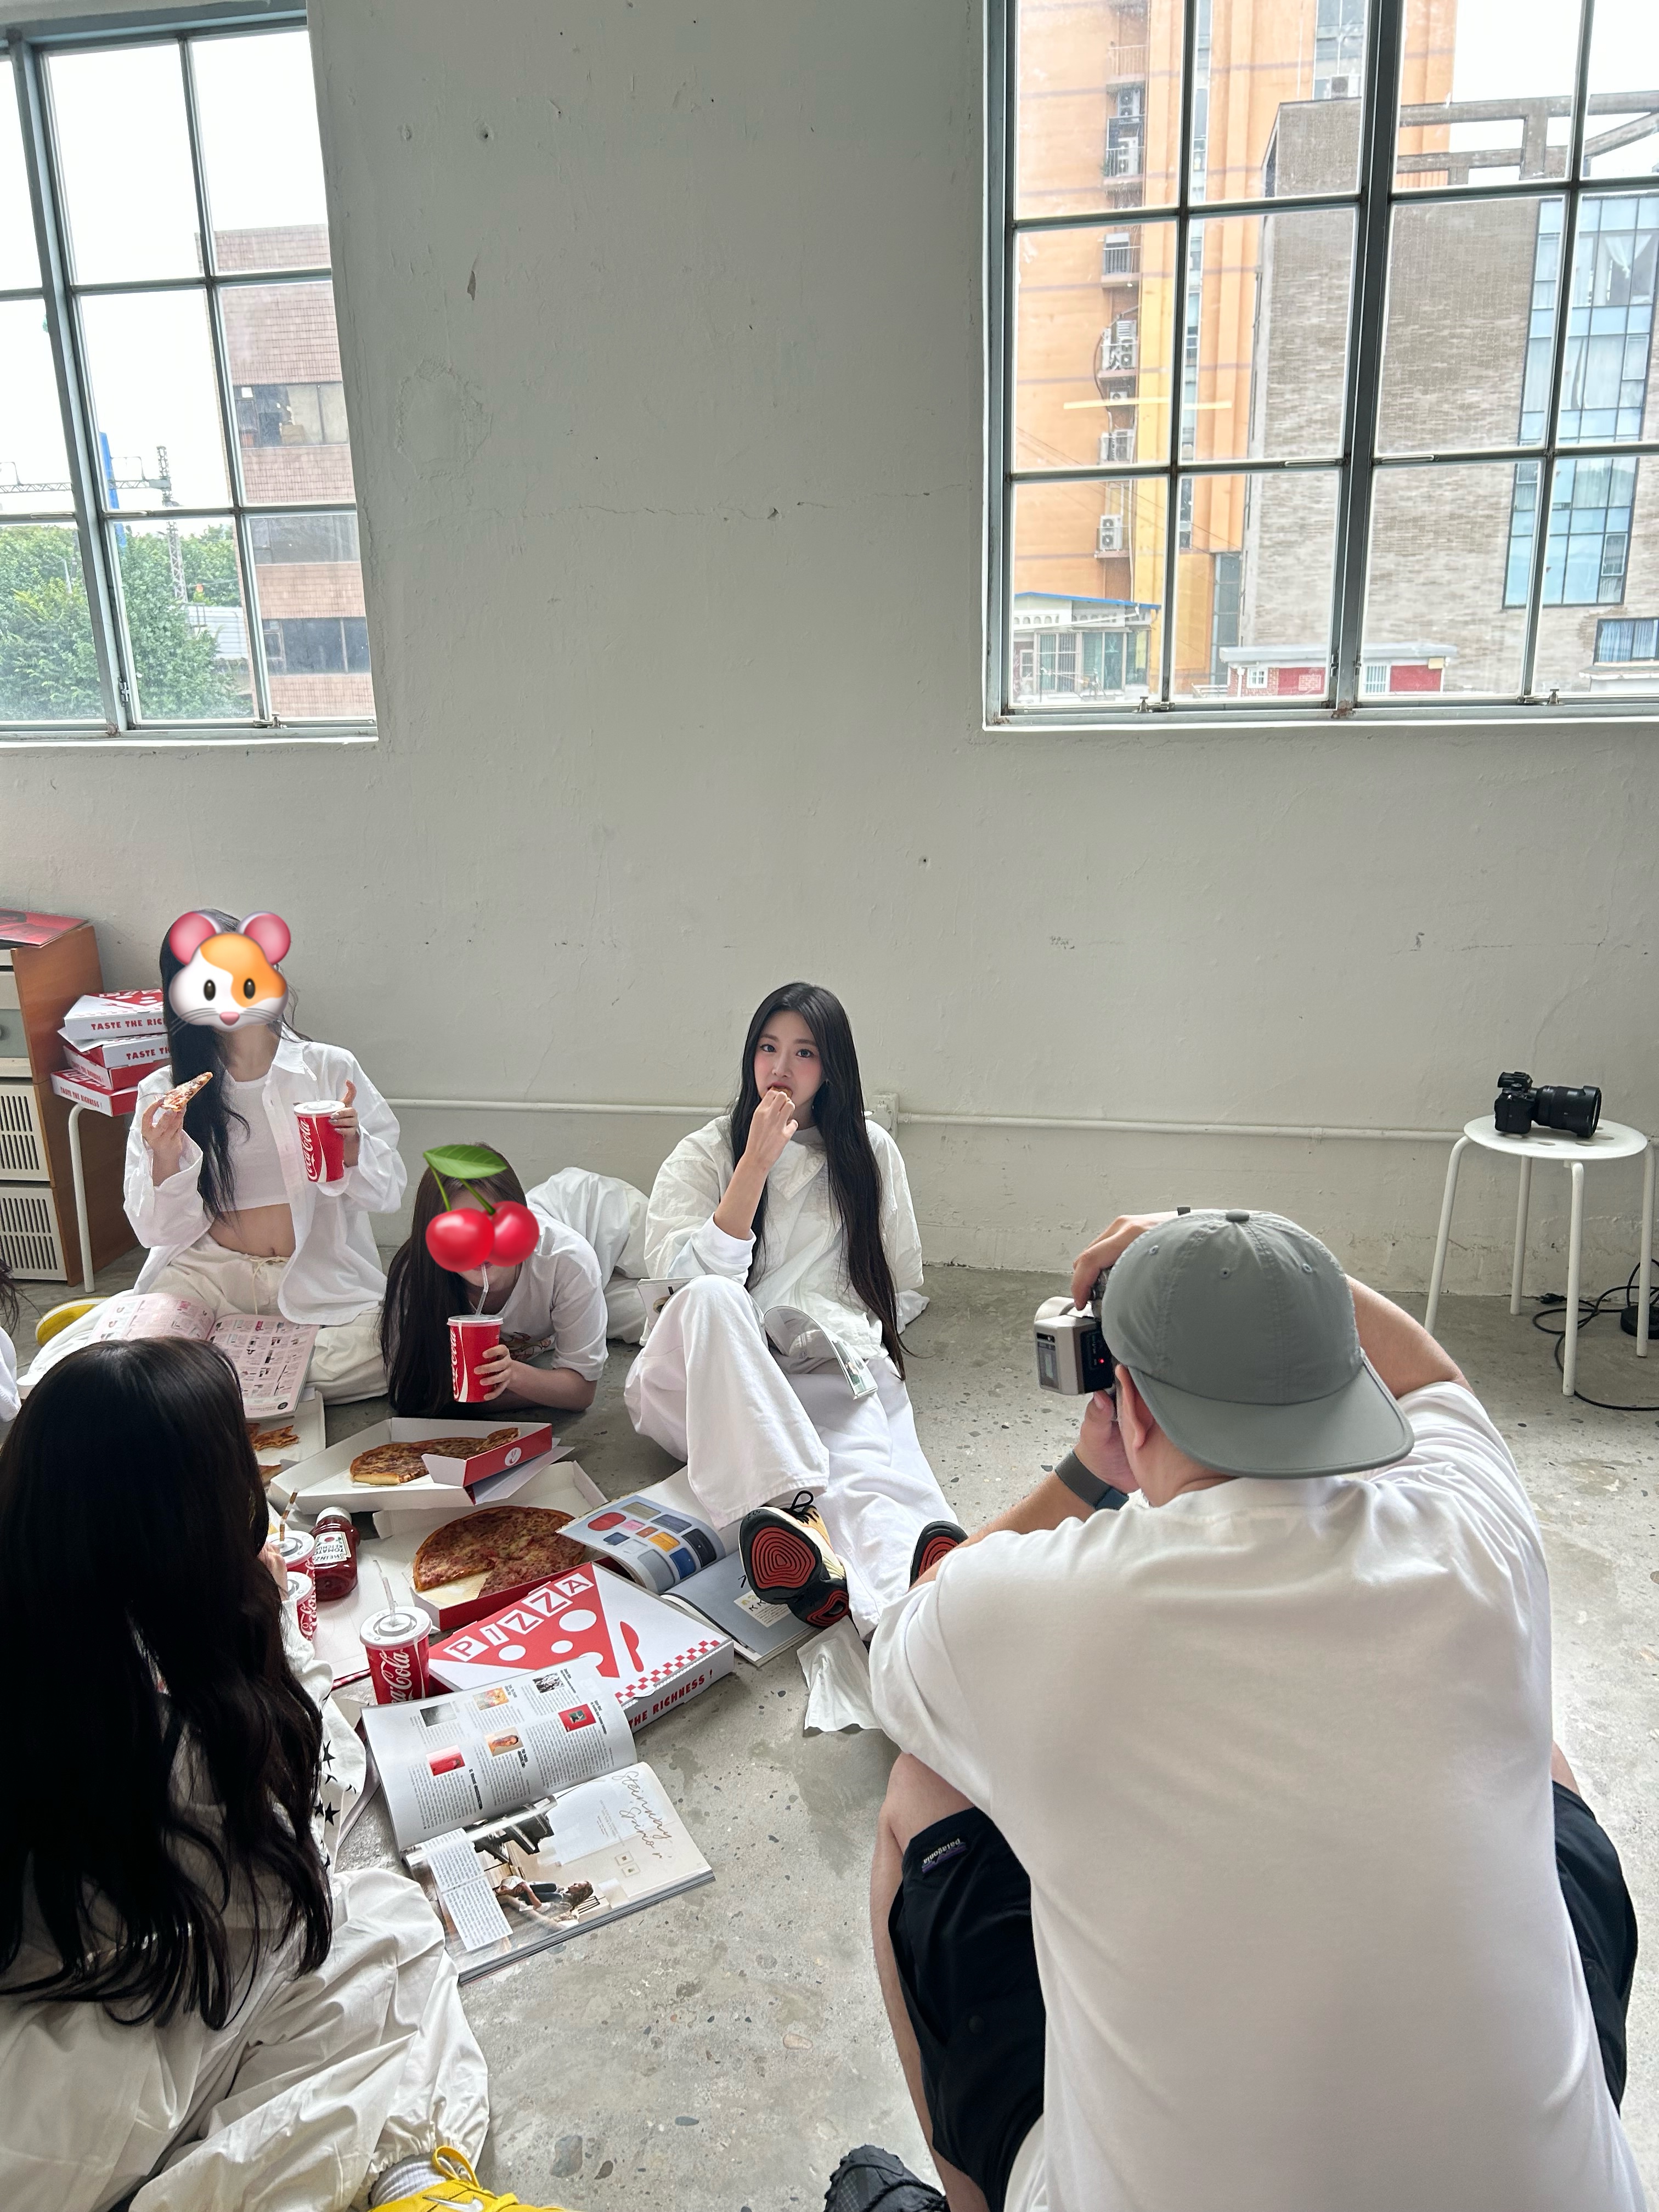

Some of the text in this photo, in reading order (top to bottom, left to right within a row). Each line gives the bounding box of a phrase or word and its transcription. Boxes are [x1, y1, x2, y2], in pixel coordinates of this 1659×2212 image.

[91, 1022, 121, 1030] TASTE
[125, 1019, 143, 1028] THE
[126, 1046, 170, 1060] TASTE TH
[448, 1578, 590, 1657] PIZZA
[628, 1710, 648, 1728] THE
[652, 1674, 705, 1715] RICHNESS
[612, 1771, 673, 1839] Steinway
[923, 1838, 961, 1864] patagonia
